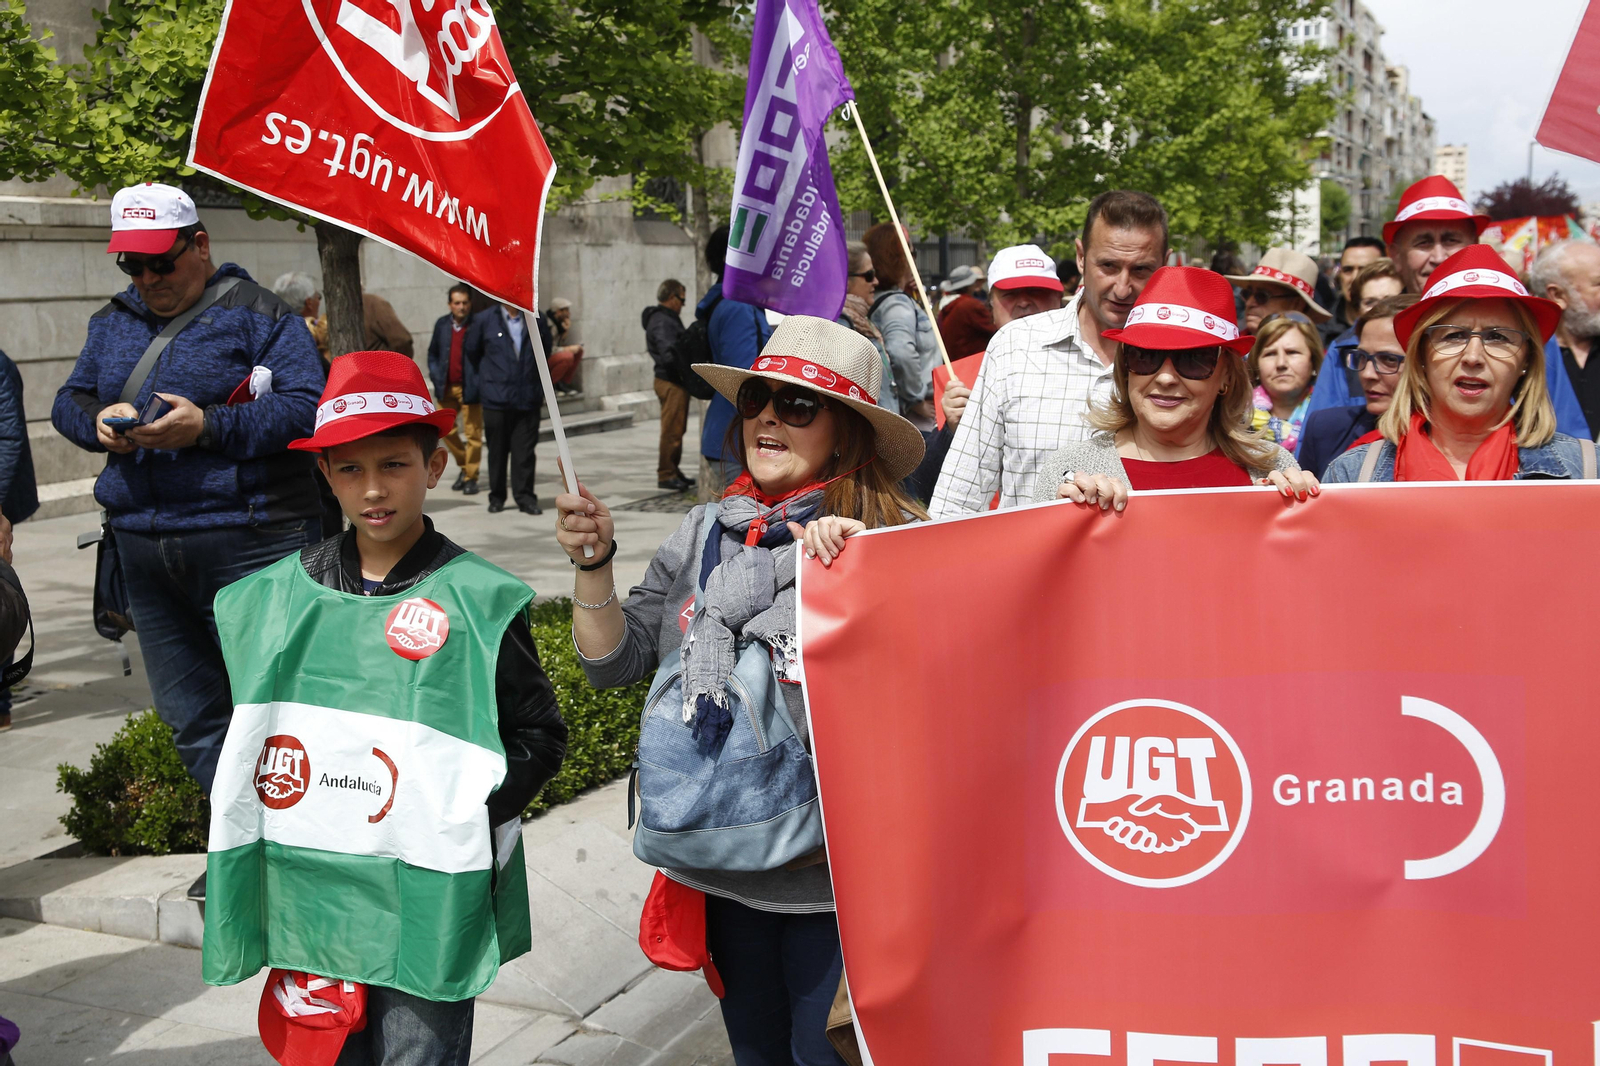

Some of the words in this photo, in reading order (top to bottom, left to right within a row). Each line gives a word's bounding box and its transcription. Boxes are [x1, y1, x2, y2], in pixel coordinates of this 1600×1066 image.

[261, 112, 491, 246] www.ugt.es
[123, 208, 155, 219] CCOO
[1016, 259, 1044, 268] CCOO
[393, 602, 445, 637] UGT
[259, 745, 304, 780] UGT
[319, 772, 382, 796] Andalucía
[1082, 735, 1217, 802] UGT
[1272, 772, 1464, 806] Granada
